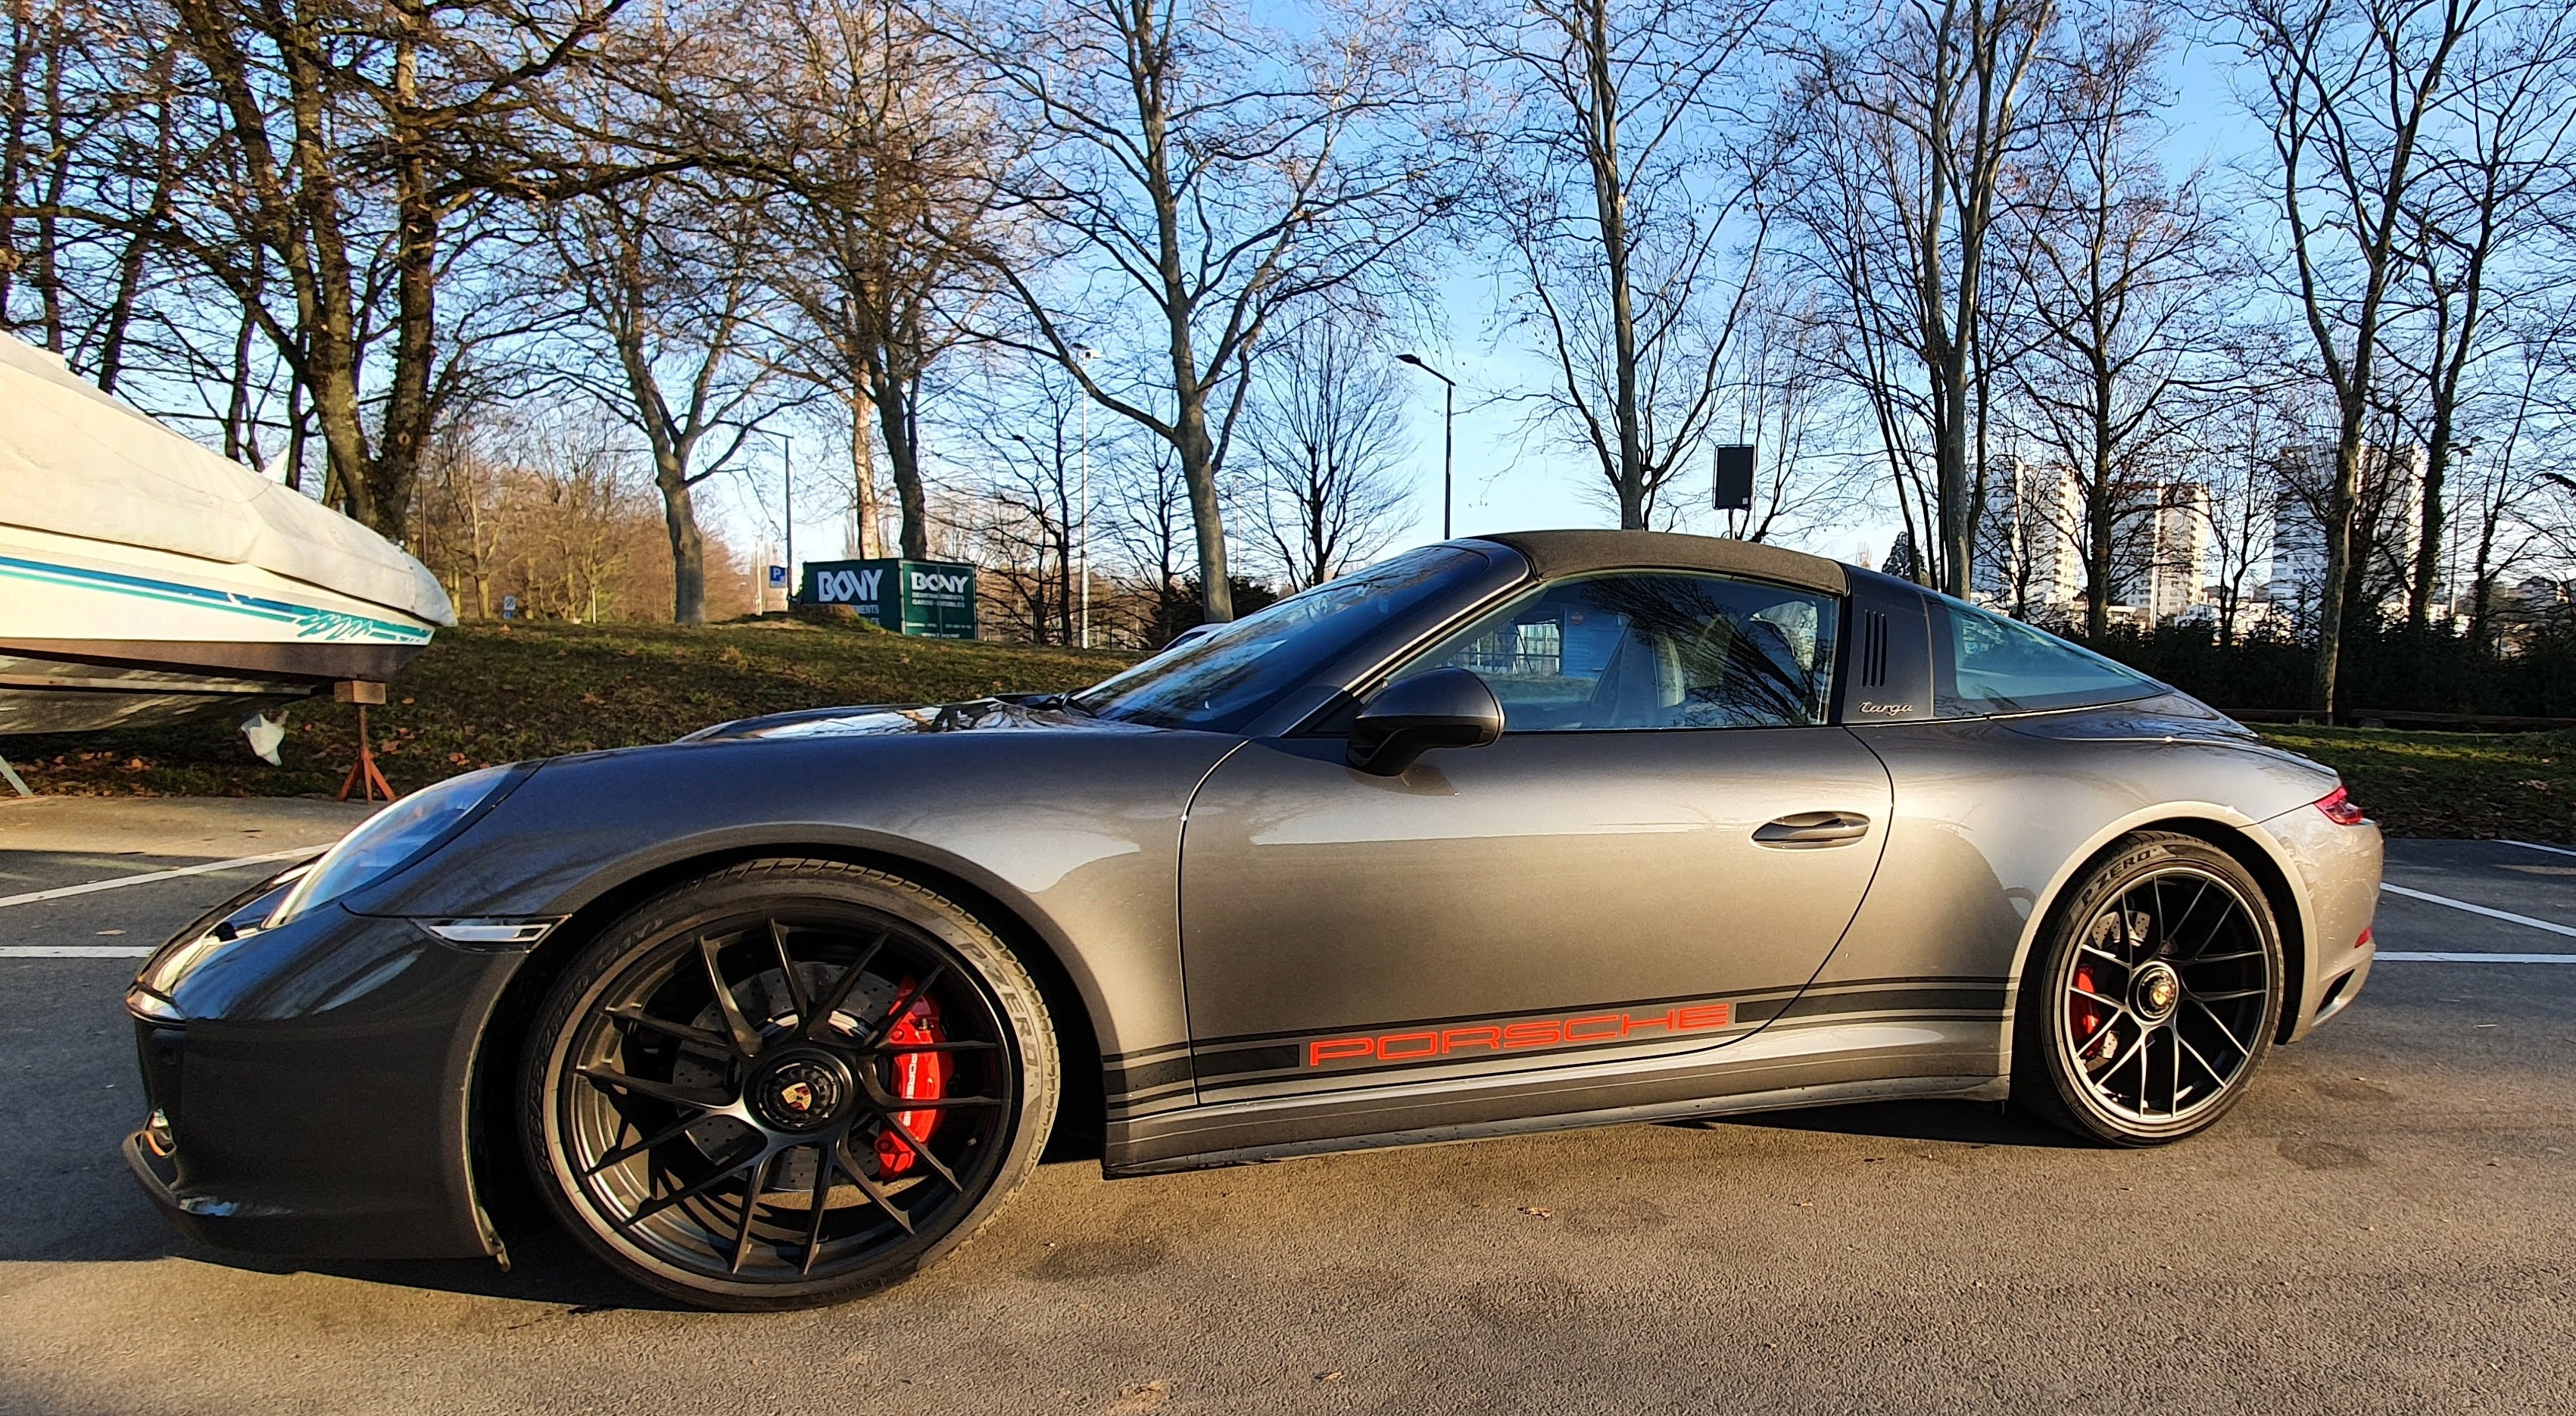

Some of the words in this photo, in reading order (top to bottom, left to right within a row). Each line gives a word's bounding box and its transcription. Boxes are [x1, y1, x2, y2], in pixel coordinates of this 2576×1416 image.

[773, 568, 781, 579] P
[2097, 850, 2150, 890] ZERO
[984, 968, 1040, 1067] ZERO
[1308, 1003, 1729, 1066] PORSCHE
[903, 1053, 918, 1127] PORSE
